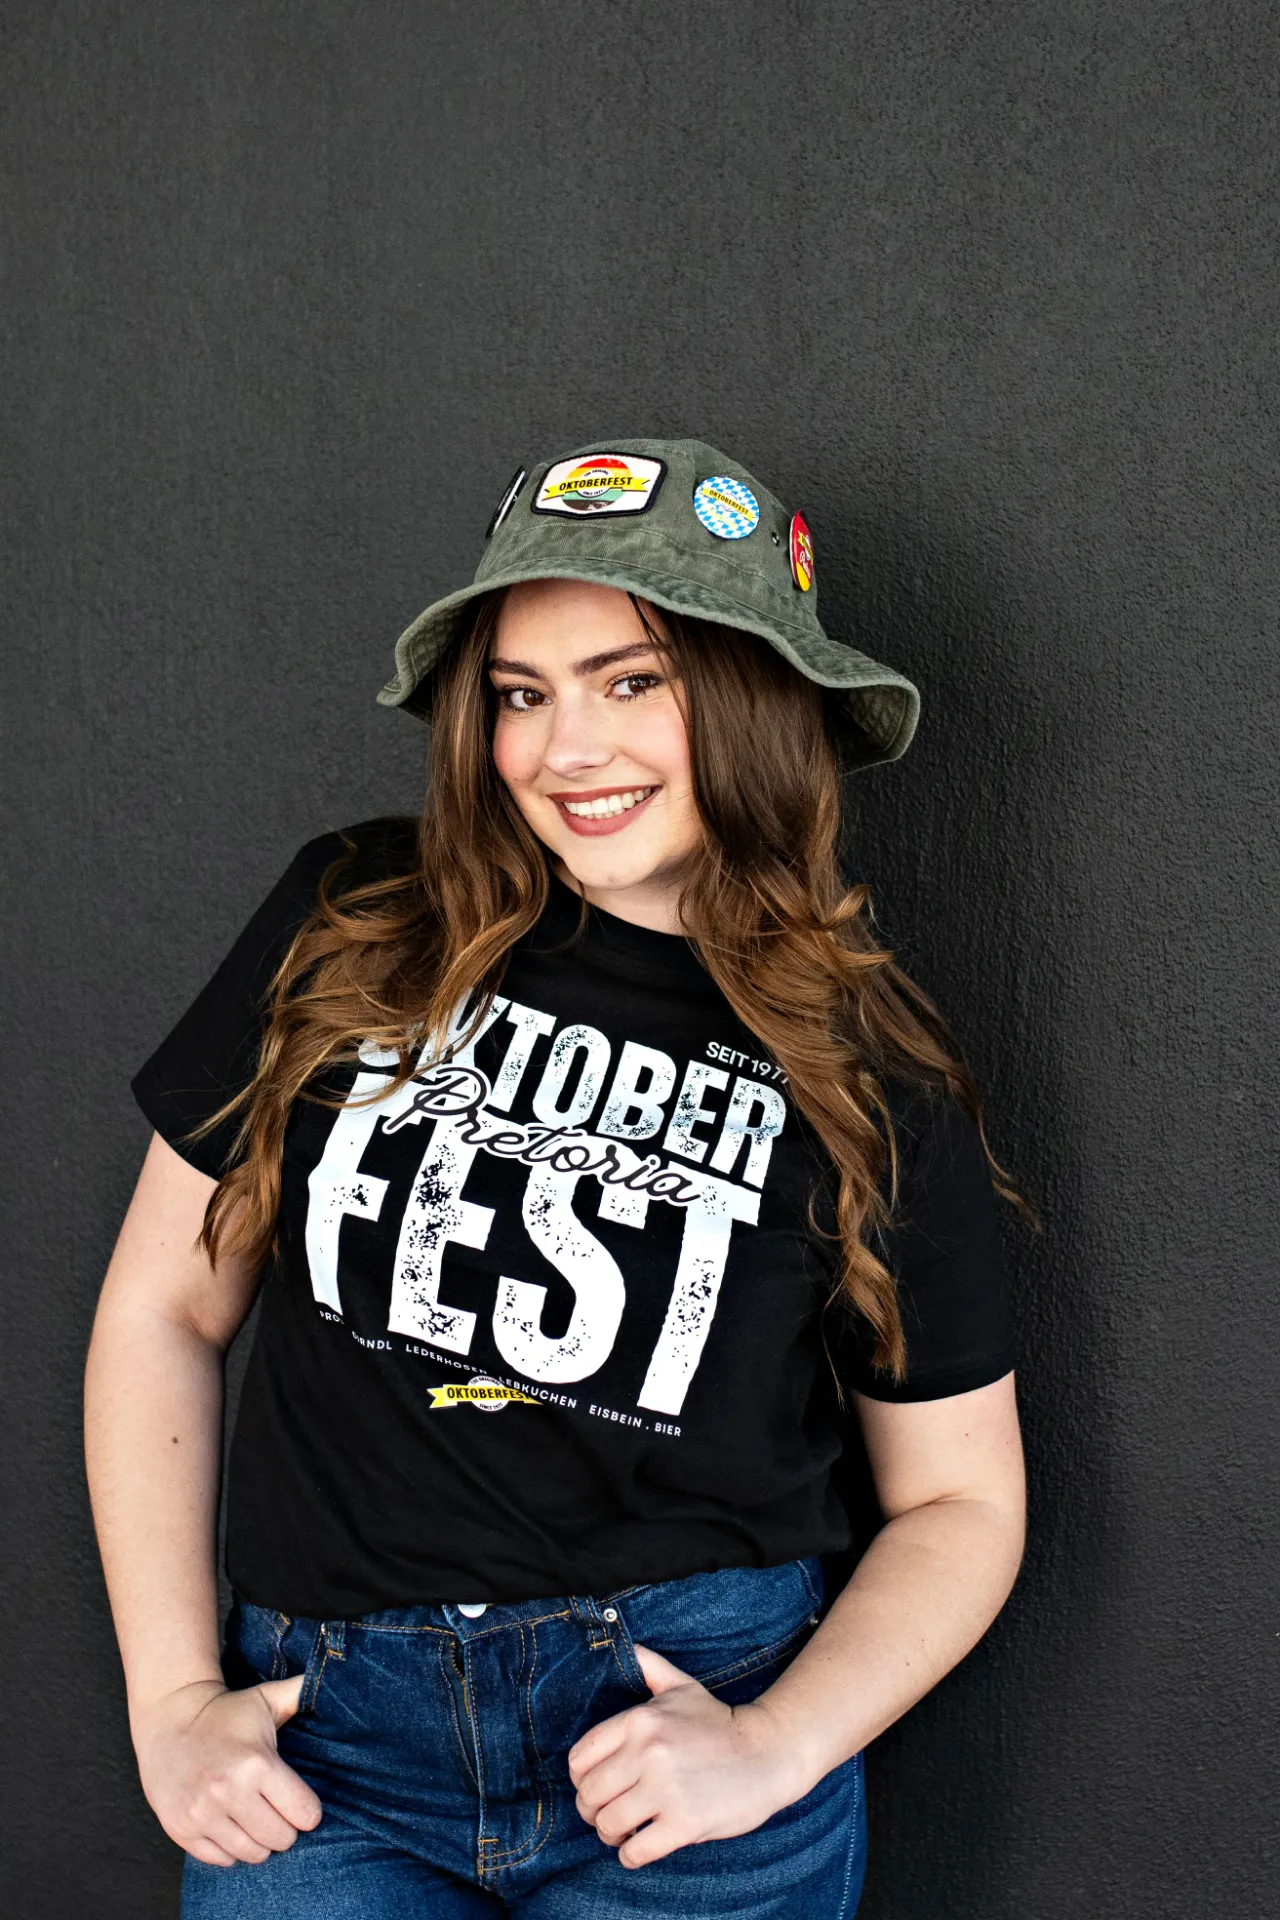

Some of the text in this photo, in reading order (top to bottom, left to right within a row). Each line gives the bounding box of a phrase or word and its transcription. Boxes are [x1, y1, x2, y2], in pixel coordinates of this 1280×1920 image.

[559, 476, 633, 491] OKTOBERFEST
[709, 489, 749, 515] OKTOBERFEST
[705, 1041, 750, 1068] SEIT
[383, 1066, 704, 1206] Pretoria
[305, 1071, 762, 1416] FEST
[406, 1343, 488, 1375] LEDERHOSEN
[499, 1376, 578, 1409] LEBKUCHEN
[589, 1404, 643, 1428] EISBEIN
[654, 1421, 682, 1437] BIER
